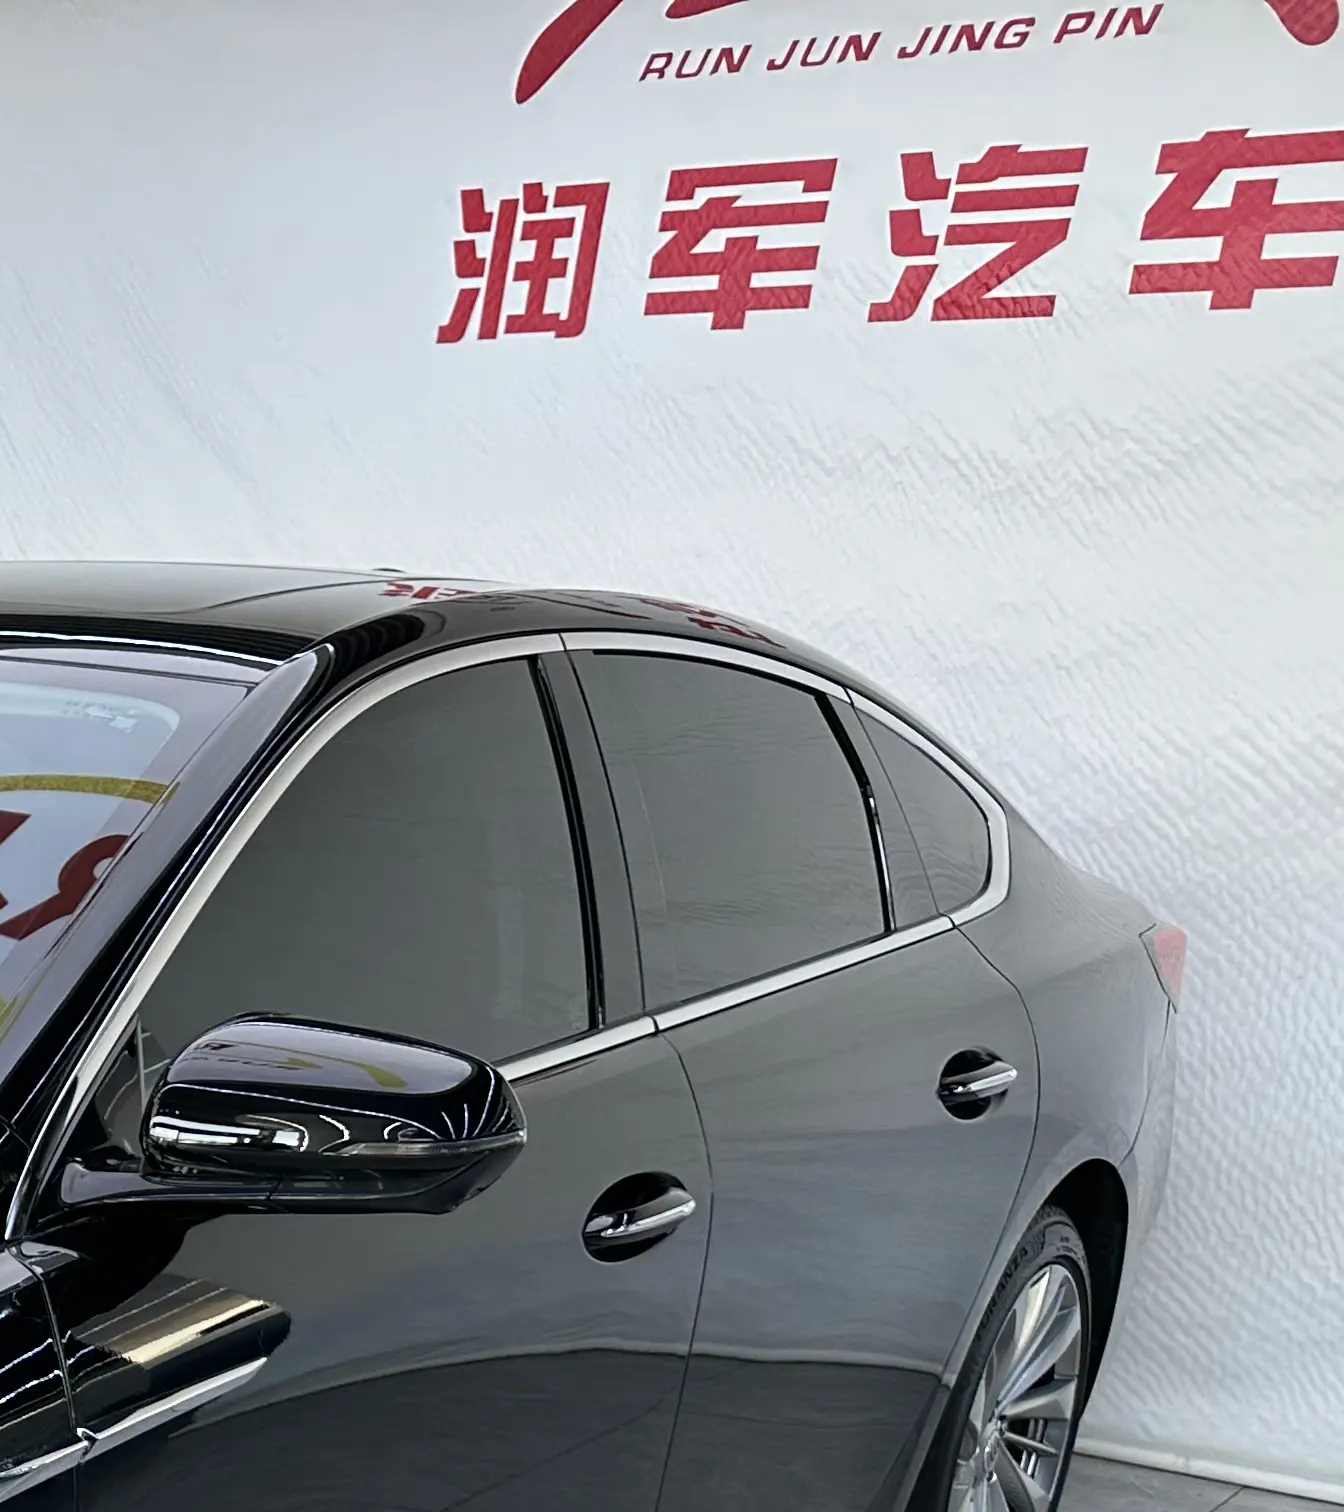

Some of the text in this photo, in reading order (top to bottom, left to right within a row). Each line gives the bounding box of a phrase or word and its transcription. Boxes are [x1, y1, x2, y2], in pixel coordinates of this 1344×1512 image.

[640, 3, 1165, 81] RUN JUN JING PIN
[436, 129, 1344, 343] 润军汽车
